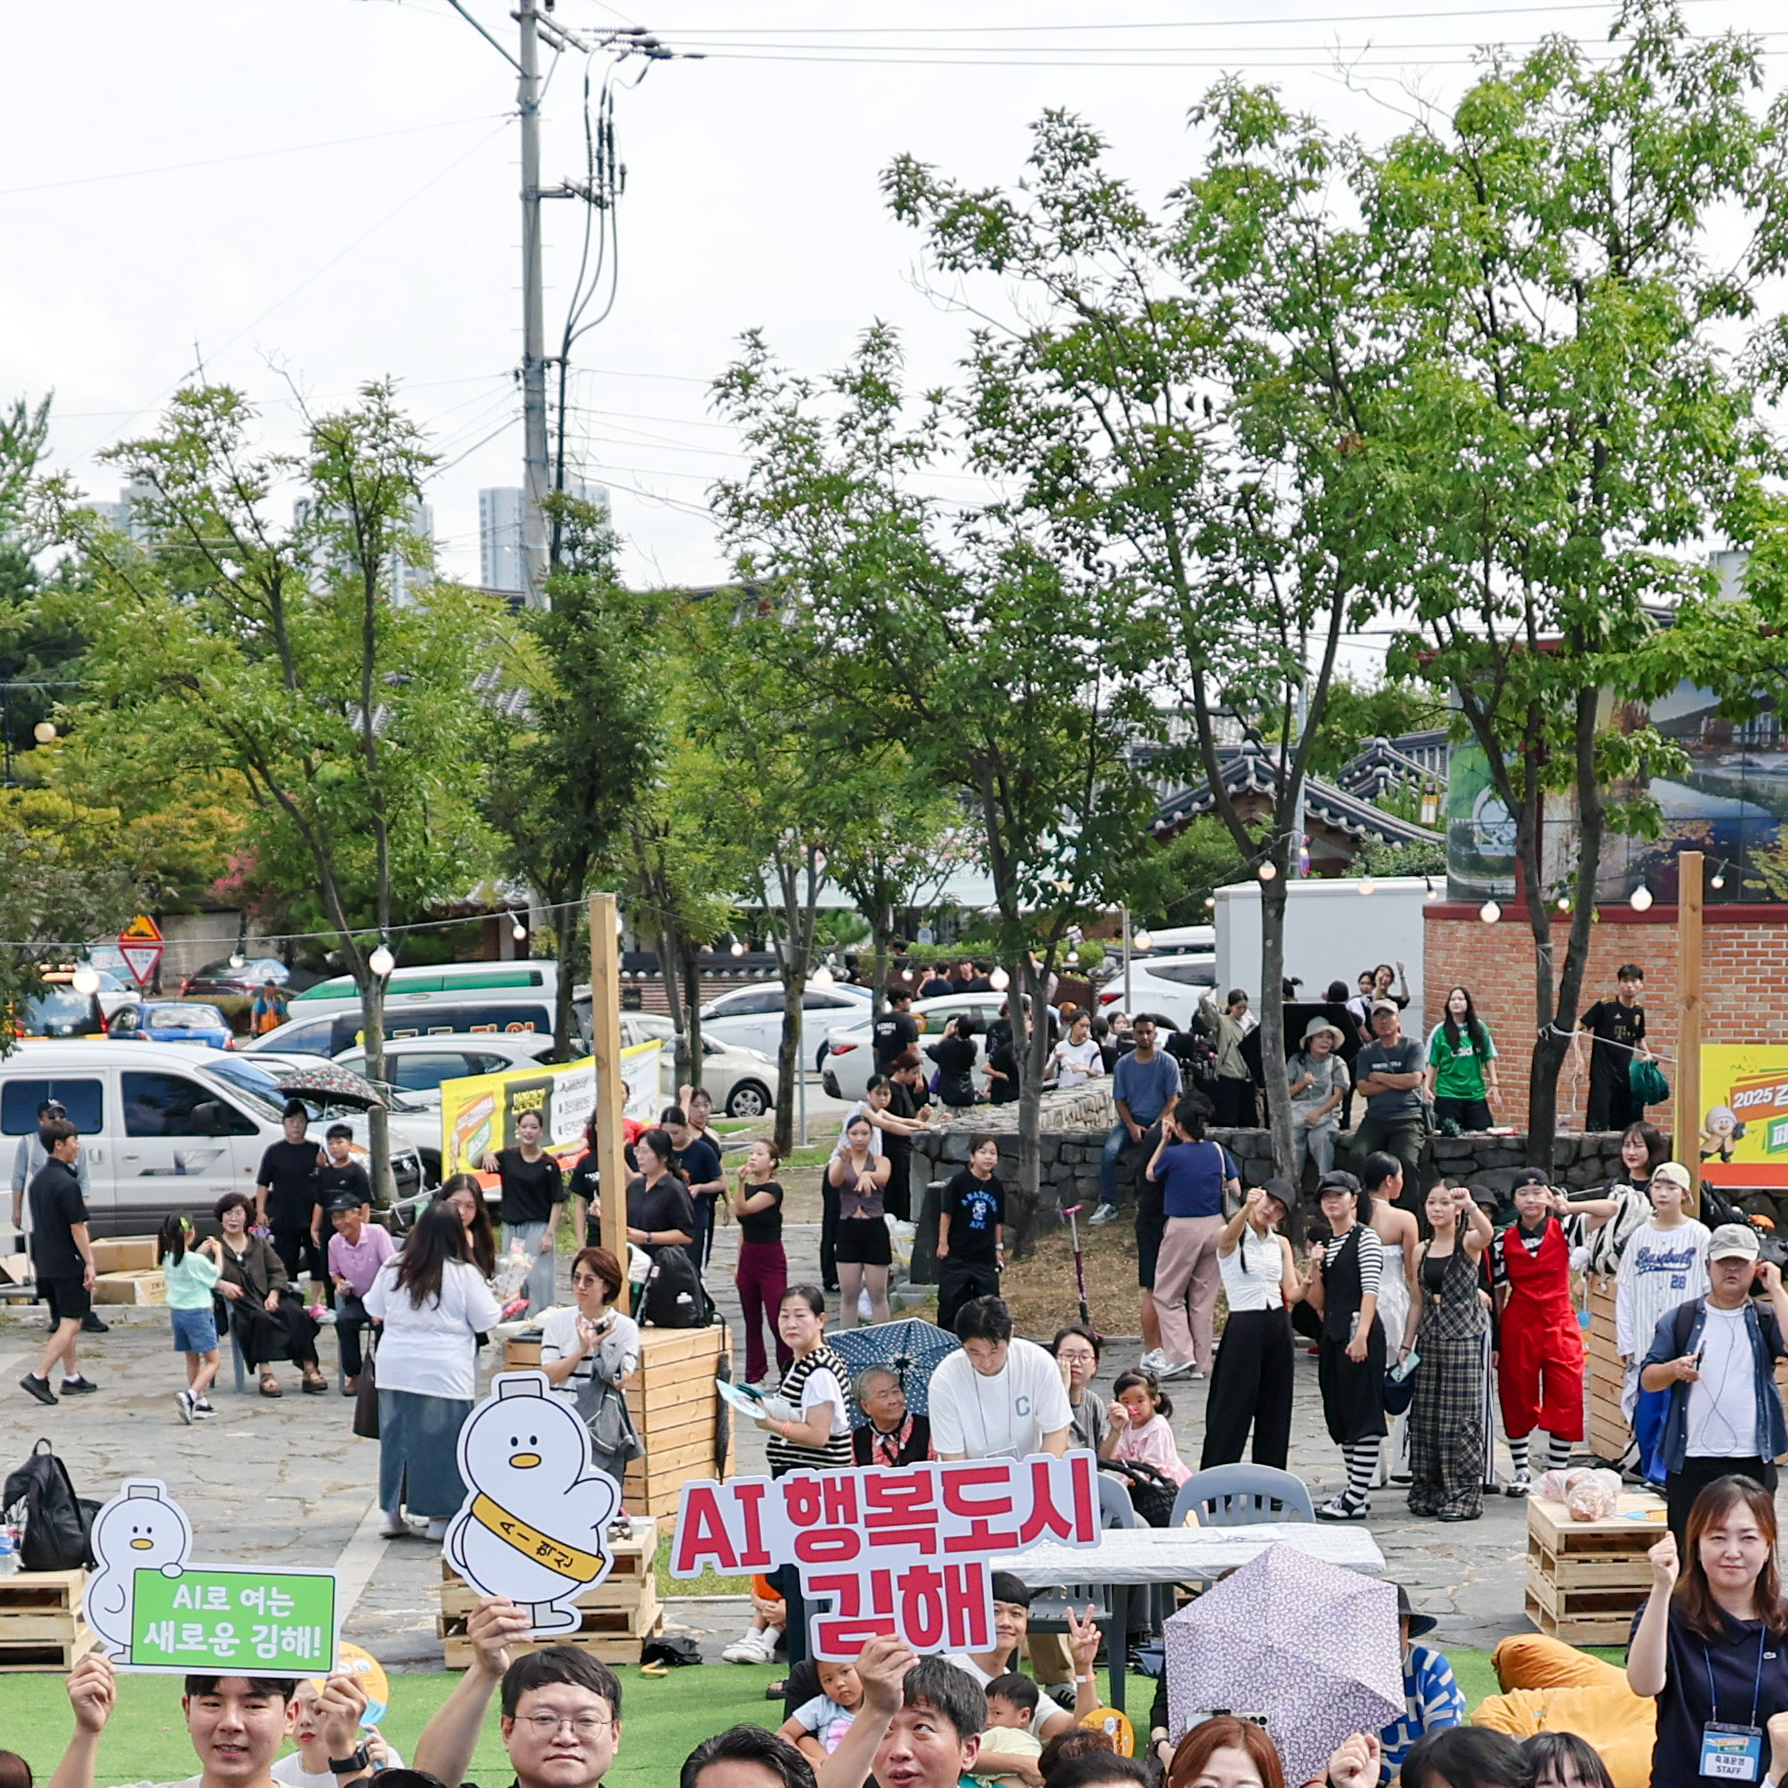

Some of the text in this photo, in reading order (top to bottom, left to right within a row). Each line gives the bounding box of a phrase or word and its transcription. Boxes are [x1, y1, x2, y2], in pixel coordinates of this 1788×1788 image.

[1733, 1087, 1774, 1109] 2025
[1670, 1274, 1687, 1290] 28
[677, 1456, 1096, 1572] AI 행복도시
[171, 1584, 296, 1618] AI로 여는
[807, 1562, 990, 1656] 김해
[142, 1620, 323, 1659] 새로운 김해!
[1716, 1765, 1742, 1775] STAFF
